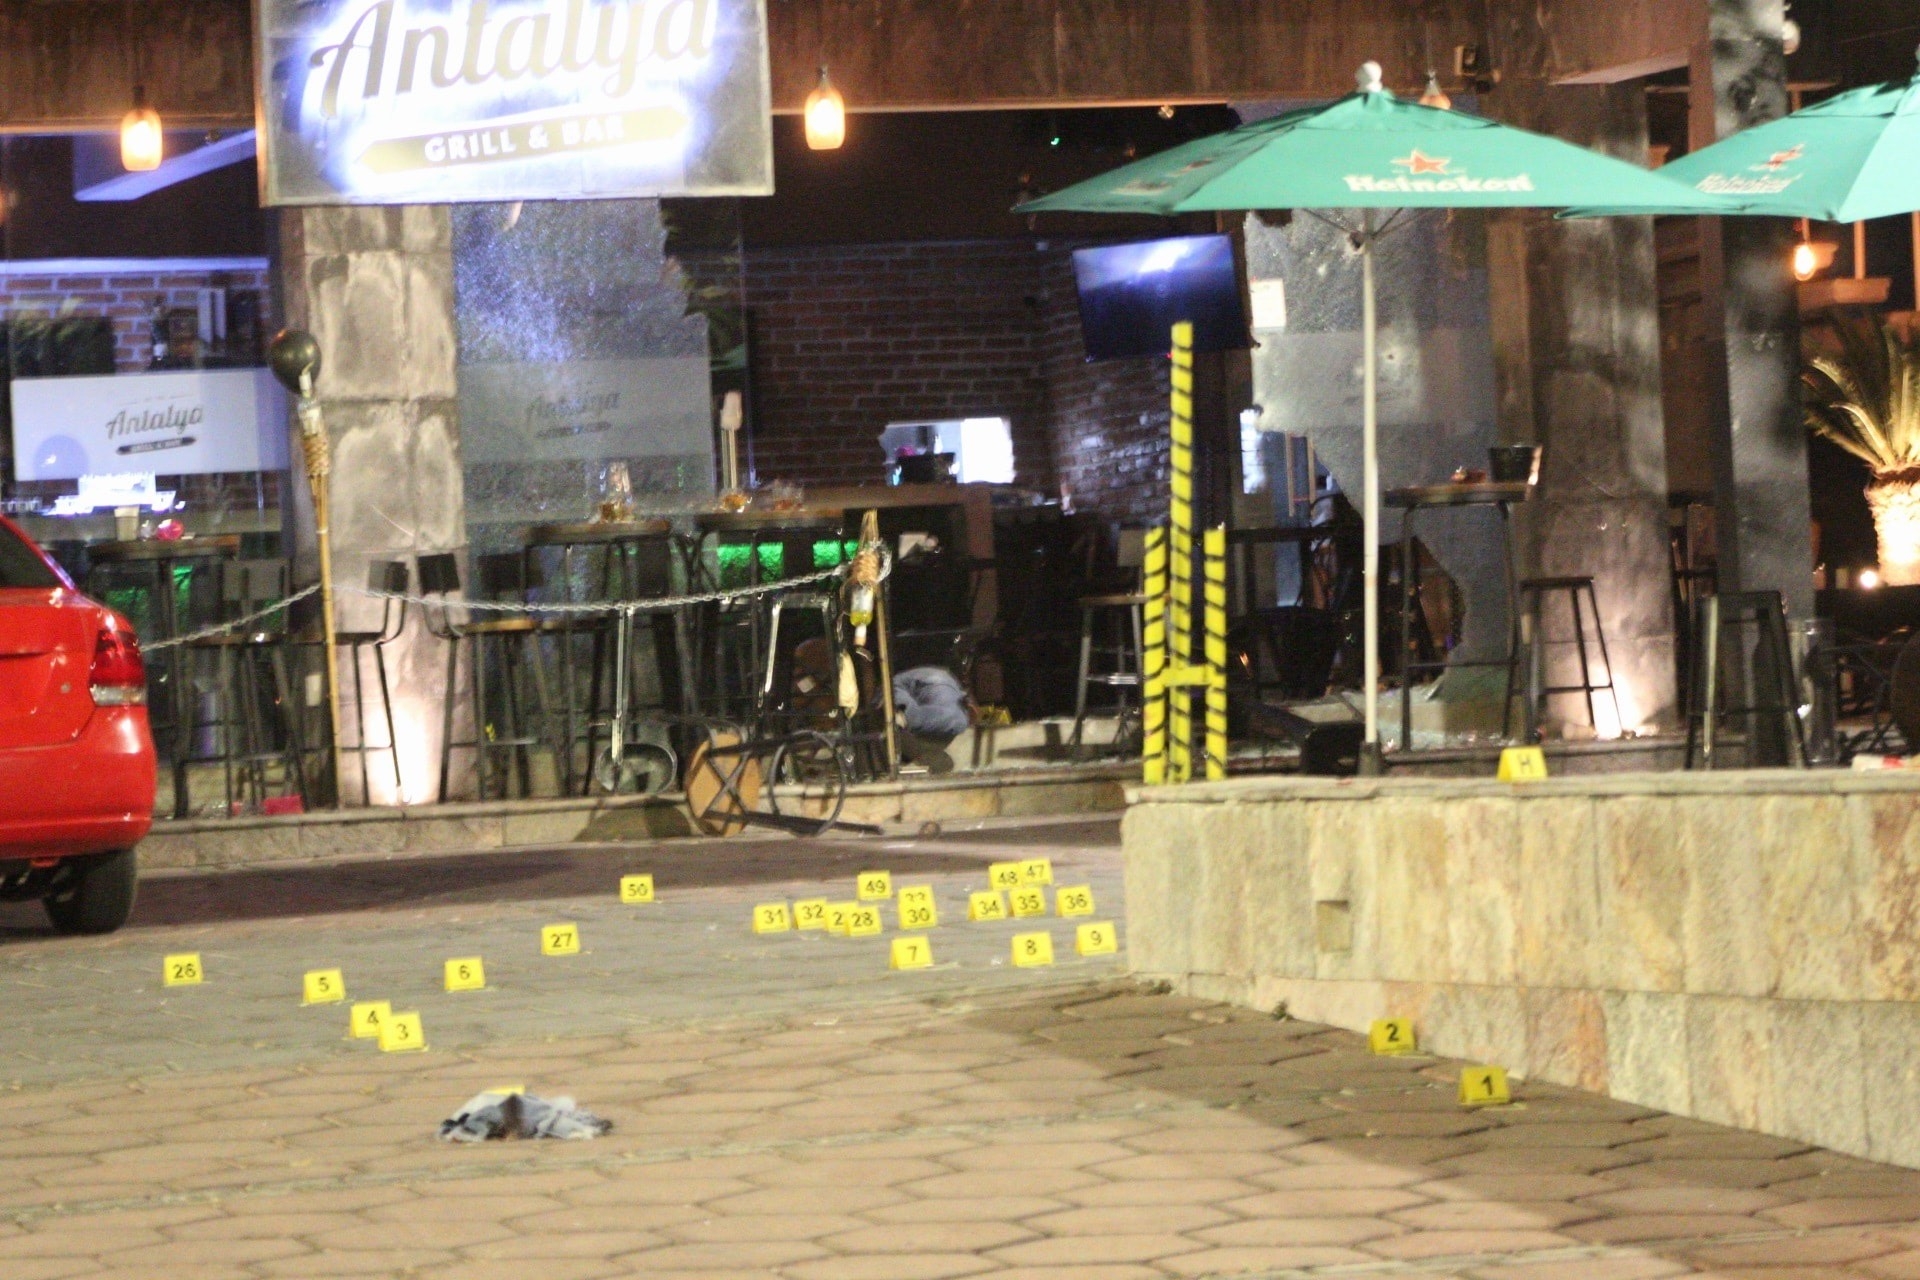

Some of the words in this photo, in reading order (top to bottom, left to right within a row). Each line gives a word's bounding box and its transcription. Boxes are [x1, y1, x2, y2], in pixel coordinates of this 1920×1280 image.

[310, 0, 712, 119] Antalya
[424, 134, 516, 163] GRILL
[529, 125, 549, 150] &
[561, 115, 624, 146] BAR
[1343, 173, 1534, 192] Heineken
[105, 404, 204, 440] Antalya
[998, 871, 1018, 885] 48
[1027, 864, 1044, 878] 47
[627, 883, 648, 897] 50
[866, 879, 886, 893] 49
[979, 899, 999, 915] 34
[1018, 894, 1039, 910] 35
[1065, 893, 1087, 909] 36
[764, 908, 784, 924] 31
[802, 904, 823, 920] 32
[851, 912, 873, 927] 28
[907, 907, 930, 924] 30
[550, 932, 572, 948] 27
[1091, 930, 1102, 946] 9
[907, 945, 917, 961] 7
[1025, 939, 1037, 956] 8
[459, 964, 470, 980] 6
[318, 976, 329, 992] 5
[367, 1010, 379, 1025] 4
[396, 1023, 408, 1041] 3
[1386, 1022, 1400, 1042] 2
[1481, 1075, 1493, 1096] 1
